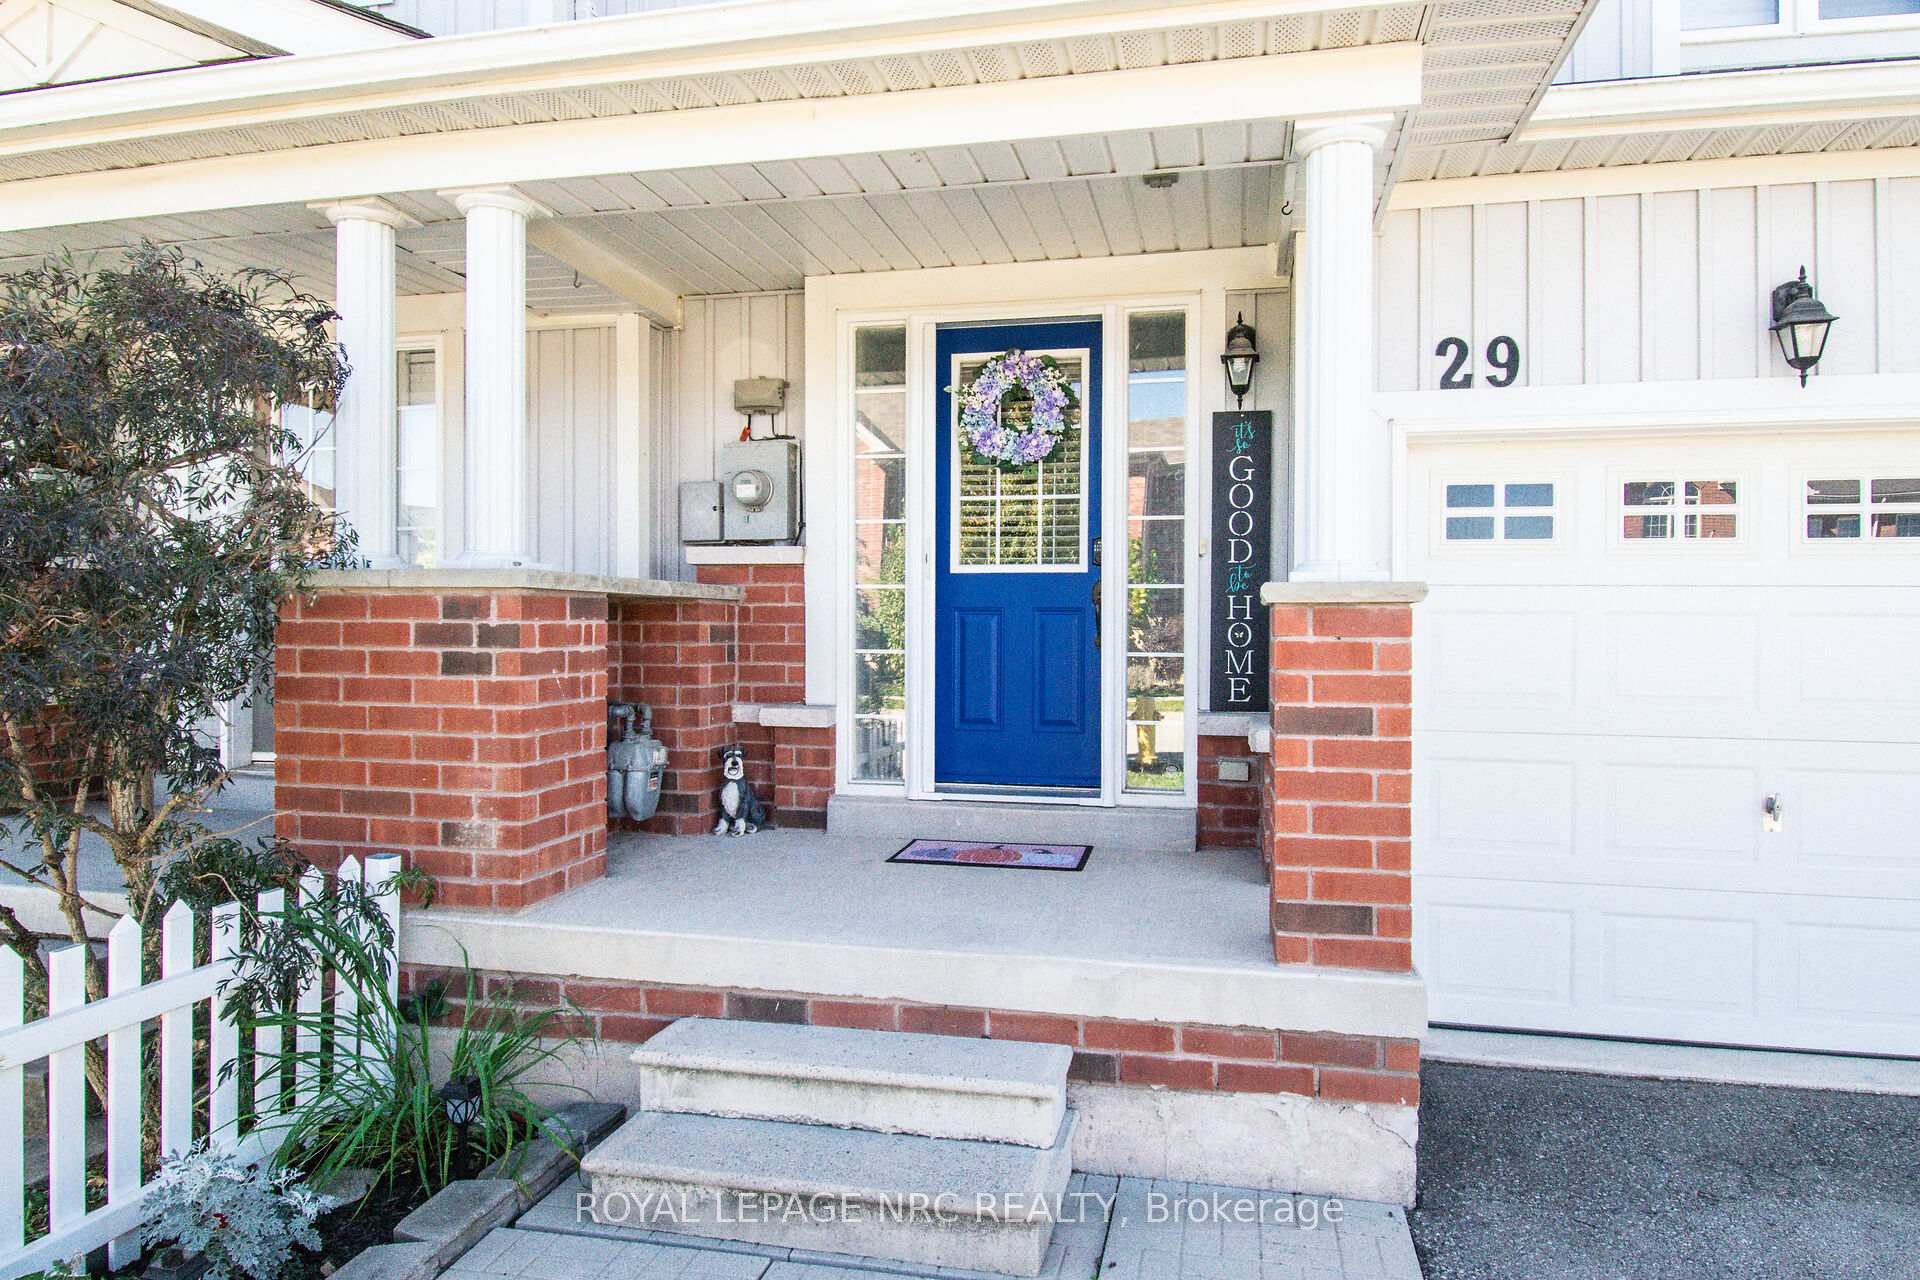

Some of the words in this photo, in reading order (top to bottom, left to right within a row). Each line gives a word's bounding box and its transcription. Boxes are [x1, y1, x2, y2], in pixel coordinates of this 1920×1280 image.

[1435, 335, 1520, 390] 29
[1231, 420, 1256, 440] it's
[1225, 438, 1250, 454] so
[1227, 455, 1256, 564] GOOD
[1224, 572, 1249, 593] be
[1229, 563, 1257, 582] to
[1224, 595, 1255, 703] HOME
